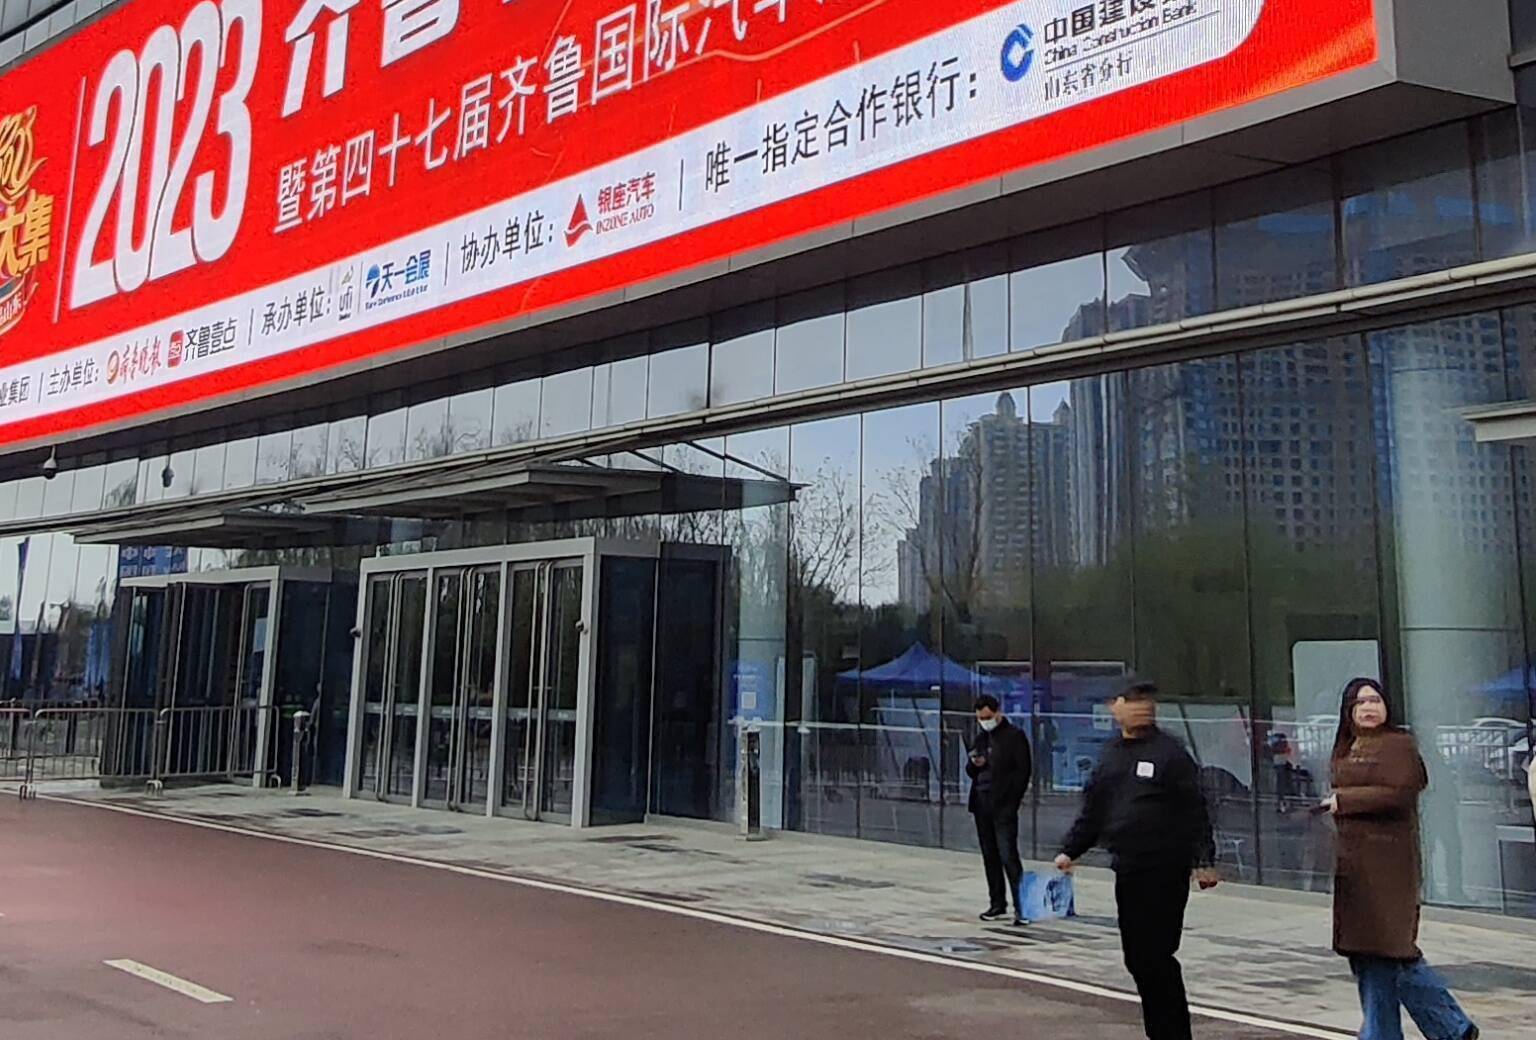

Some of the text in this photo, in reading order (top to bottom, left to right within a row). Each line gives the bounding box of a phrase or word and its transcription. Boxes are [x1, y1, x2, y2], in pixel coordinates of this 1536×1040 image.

[1044, 50, 1134, 101] 山东省分行
[597, 171, 656, 214] 银座汽车
[380, 249, 432, 293] 天一会展
[184, 316, 238, 362] 齐鲁壹点
